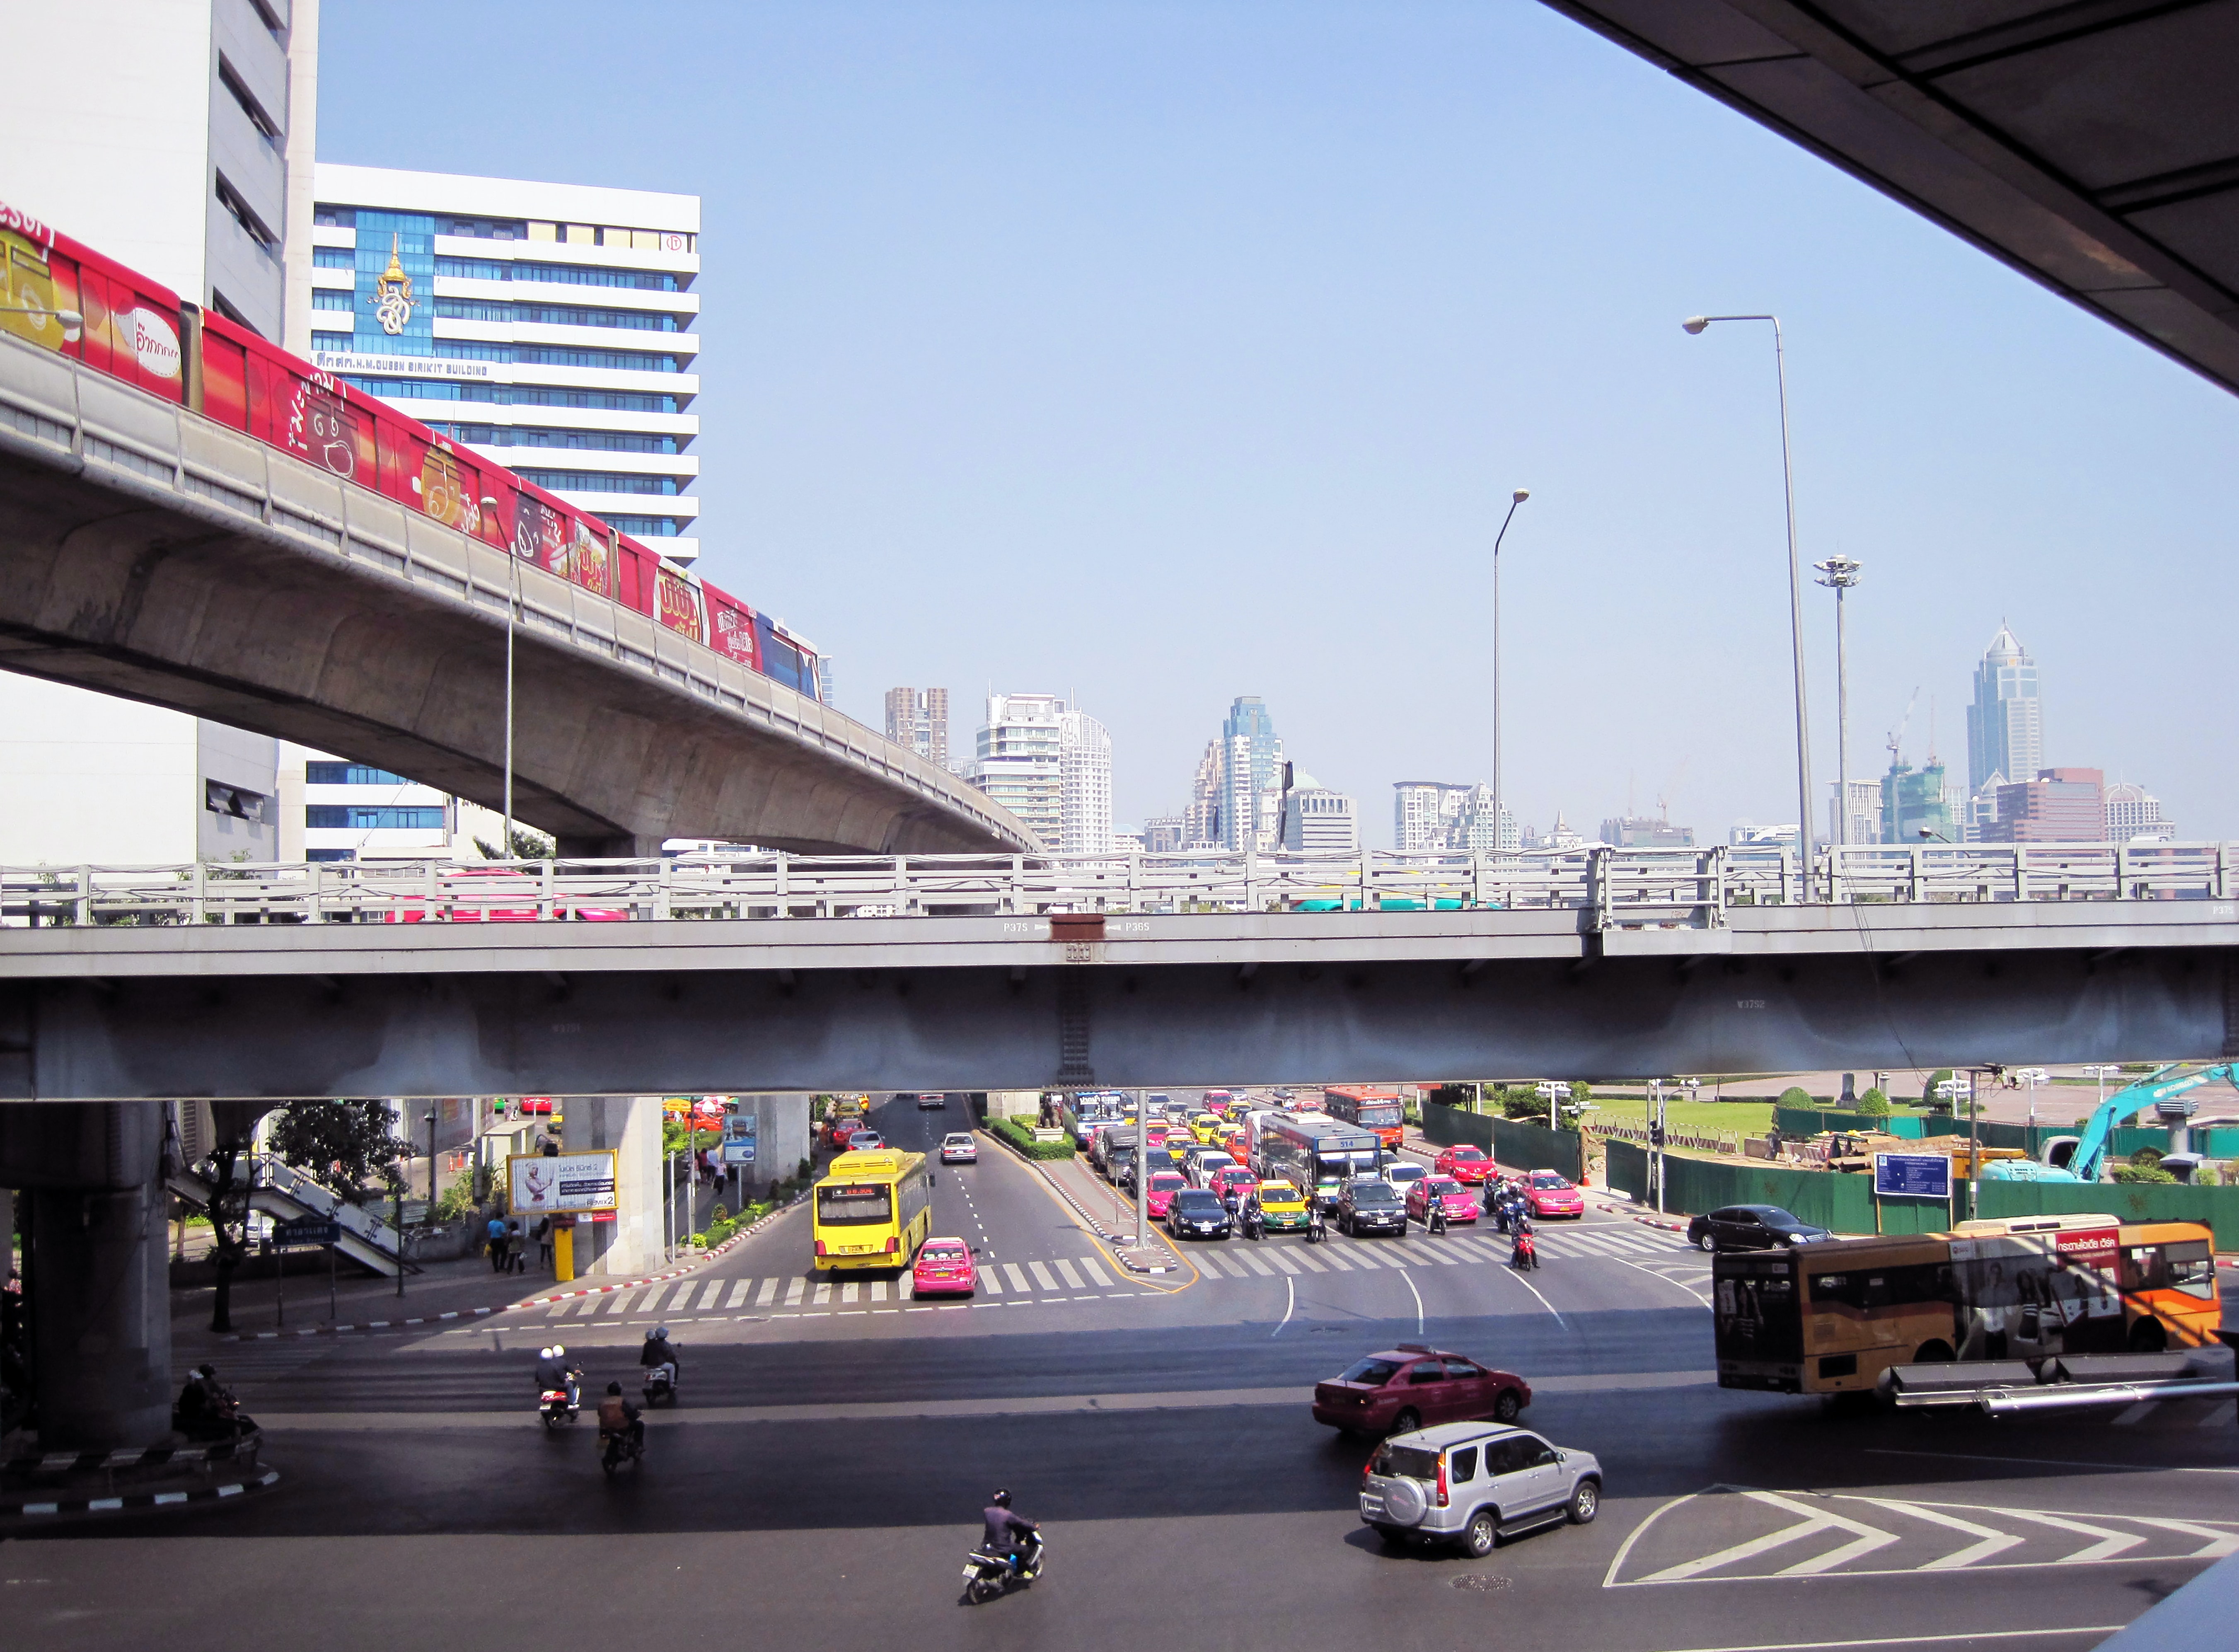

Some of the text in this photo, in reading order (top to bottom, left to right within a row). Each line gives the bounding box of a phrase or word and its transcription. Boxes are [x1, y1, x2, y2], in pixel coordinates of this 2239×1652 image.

[408, 362, 442, 373] SIRIKIT
[447, 364, 487, 376] BUILDING
[1003, 923, 1028, 932] P37S
[1126, 922, 1150, 931] P36S
